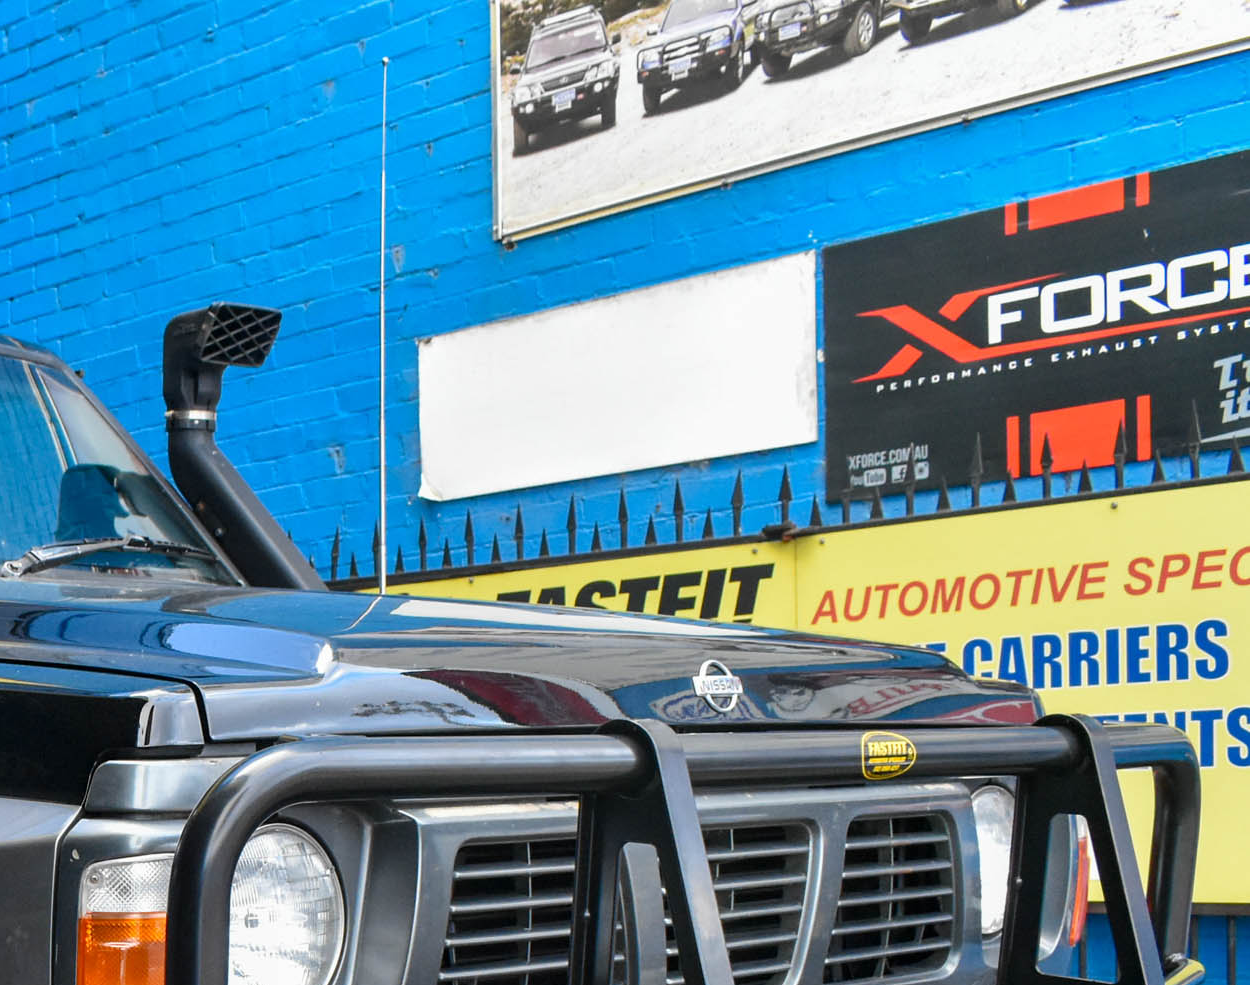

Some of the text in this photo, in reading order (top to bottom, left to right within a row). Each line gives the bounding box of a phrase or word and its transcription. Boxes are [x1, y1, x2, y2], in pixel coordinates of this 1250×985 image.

[876, 358, 1033, 393] PERFORMANCE
[1050, 335, 1158, 362] EXHAUST
[848, 443, 929, 470] XFORCE.COMAU
[811, 561, 1109, 625] AUTOMOTIVE
[962, 618, 1230, 689] CARRIERS
[700, 678, 740, 693] NISSAN
[867, 740, 908, 757] FASTFIT
